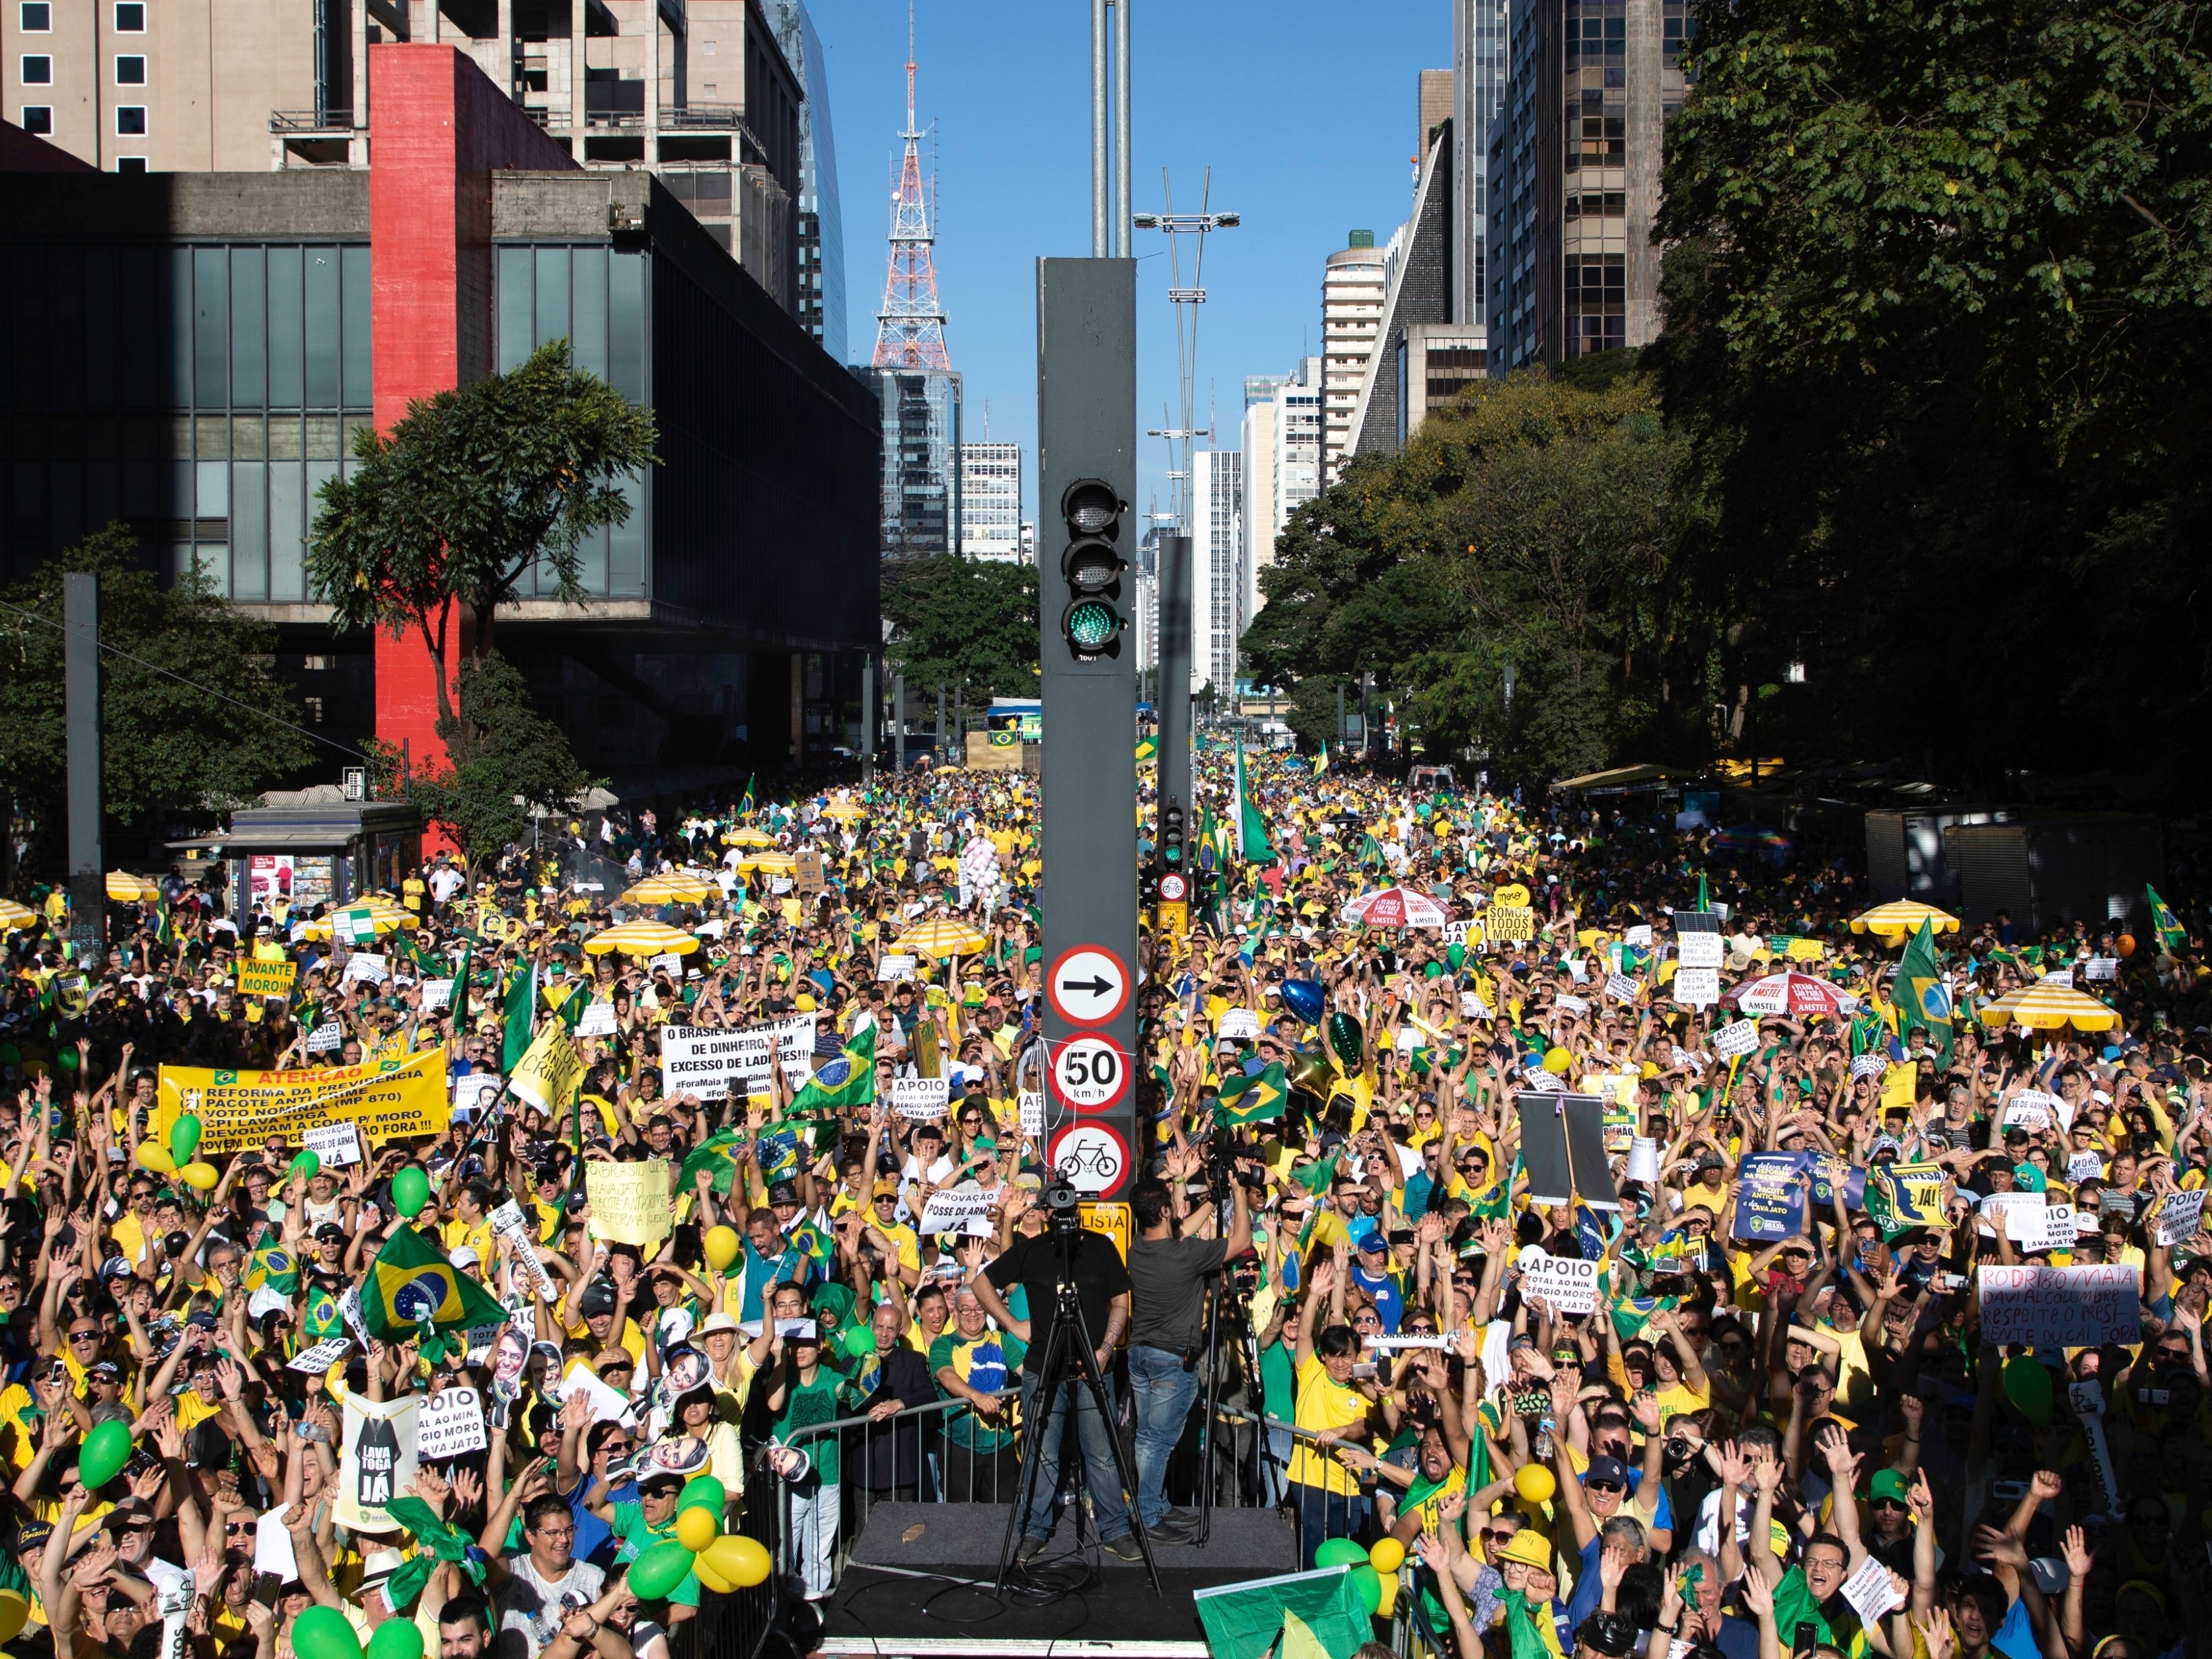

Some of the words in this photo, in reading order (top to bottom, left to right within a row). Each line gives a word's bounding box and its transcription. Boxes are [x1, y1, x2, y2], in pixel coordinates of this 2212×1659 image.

[1409, 904, 1435, 913] AMSTEL
[1490, 907, 1530, 918] SOMOS
[1490, 918, 1529, 929] TODOS
[1493, 929, 1528, 940] MORO
[651, 954, 678, 964] APOIO
[245, 961, 292, 977] AVANTE
[889, 971, 903, 980] JÁ
[365, 974, 376, 982] JÁ
[1611, 971, 1637, 989] APOIO
[242, 978, 291, 993] MORO!!!
[1751, 988, 1781, 998] AMSTEL
[435, 996, 449, 1006] JÁ
[1748, 1002, 1778, 1011] AMSTEL
[1798, 1003, 1828, 1012] AMSTEL
[1474, 1008, 1487, 1017] JÁ
[589, 1023, 603, 1035] JÁ
[667, 1029, 676, 1040] O
[679, 1027, 721, 1039] BRASIL
[751, 1020, 775, 1033] TEM
[1233, 1026, 1248, 1037] JÁ
[1716, 1021, 1750, 1041] APOIO
[692, 1044, 707, 1055] DE
[710, 1037, 768, 1054] DINHEIRO,
[1740, 1035, 1755, 1045] MORO
[1743, 1042, 1757, 1051] JATO
[545, 1027, 580, 1078] PACOTE
[671, 1059, 723, 1073] EXCESSO
[727, 1058, 742, 1069] DE
[1064, 1050, 1117, 1086] 50
[1851, 1056, 1885, 1068] APOIO
[258, 1064, 363, 1084] ATENÇÃO
[207, 1088, 285, 1097] REFORMA
[291, 1087, 312, 1096] DA
[317, 1070, 424, 1093] PREVIDÊNCIA
[675, 1078, 721, 1089] #ForaMaia
[897, 1080, 945, 1092] APOIO
[206, 1099, 269, 1107] PACOTE
[275, 1095, 312, 1106] ANTI
[318, 1087, 369, 1101] CRIME
[1074, 1088, 1105, 1099] km/h
[206, 1109, 249, 1117] VOTO
[255, 1102, 330, 1116] NOMINAL
[335, 1096, 363, 1108] (MP
[368, 1092, 402, 1103] 870)
[2020, 1100, 2028, 1109] DE
[2030, 1101, 2048, 1111] ARMA
[206, 1119, 231, 1128] CPI
[238, 1116, 279, 1126] LAVA
[283, 1111, 328, 1122] TOGA
[2012, 1111, 2031, 1123] JÁ
[205, 1123, 291, 1138] DEVOLVAM
[296, 1121, 307, 1130] A
[311, 1117, 353, 1128] COAF
[358, 1115, 370, 1124] P/
[375, 1110, 423, 1123] MORO
[246, 1136, 266, 1146] OU
[383, 1121, 418, 1134] FORA
[420, 1120, 432, 1130] !!!
[306, 1124, 352, 1138] APROVAÇÃO
[307, 1140, 326, 1151] POSSE
[328, 1138, 337, 1148] DE
[337, 1134, 355, 1146] ARMA
[325, 1150, 344, 1165] JÁ
[2073, 1156, 2099, 1167] MORO
[589, 1165, 598, 1175] O
[598, 1164, 645, 1178] BRASIL
[1755, 1167, 1789, 1177] REFORMA
[1757, 1161, 1782, 1171] defesa
[1782, 1163, 1792, 1171] da
[2075, 1166, 2099, 1177] TRUST
[1754, 1173, 1800, 1184] PREVIDÊNCIA
[1751, 1192, 1790, 1202] ANTICRIME
[1757, 1186, 1785, 1195] PACOTE
[1917, 1185, 1936, 1207] JÁ!
[934, 1192, 994, 1203] APROVAÇÃO
[927, 1203, 953, 1216] POSSE
[955, 1206, 966, 1216] DE
[967, 1206, 992, 1216] ARMA
[1751, 1204, 1771, 1213] LAVA
[1769, 1206, 1788, 1214] JATO
[2159, 1211, 2174, 1221] TOTAL
[2175, 1207, 2184, 1216] AO
[942, 1218, 969, 1234] JÁ
[2161, 1218, 2180, 1232] SÉRGIO
[2180, 1212, 2198, 1224] MORO
[2047, 1229, 2073, 1237] MORO
[2171, 1229, 2186, 1241] LAVA
[2026, 1240, 2050, 1249] LAVA
[2051, 1237, 2075, 1246] JATO
[1529, 1258, 1593, 1277] APOIO
[1528, 1275, 1554, 1285] TOTAL
[1572, 1280, 1592, 1289] MIN.
[1526, 1284, 1561, 1296] SÉRGIO
[1563, 1289, 1593, 1300] MORO
[1565, 1301, 1592, 1310] JATO
[2064, 1306, 2074, 1319] O
[2043, 1329, 2062, 1344] OU
[2100, 1324, 2138, 1343] FORA
[309, 1347, 336, 1360] TOTAL
[435, 1415, 450, 1426] AO
[453, 1409, 477, 1422] MIN.
[445, 1422, 480, 1438] MORO
[450, 1435, 481, 1450] JATO
[363, 1444, 391, 1459] LAVA
[361, 1456, 392, 1471] TOGA
[360, 1471, 390, 1503] JÁ
[20, 1526, 52, 1545] Brasil
[1855, 1574, 1865, 1586] quero
[1851, 1583, 1867, 1600] Reforma
[1862, 1588, 1872, 1599] Paulo
